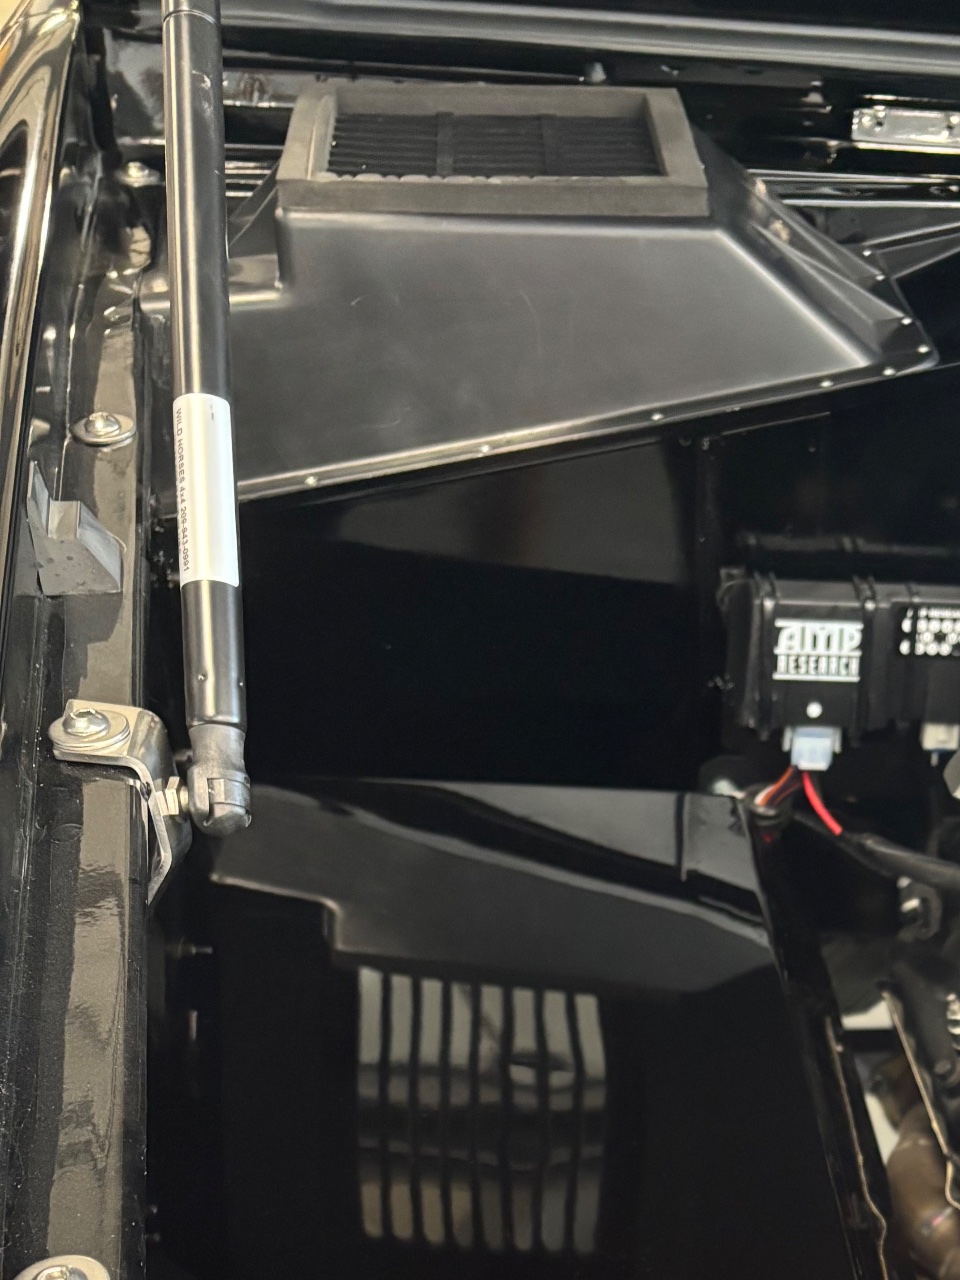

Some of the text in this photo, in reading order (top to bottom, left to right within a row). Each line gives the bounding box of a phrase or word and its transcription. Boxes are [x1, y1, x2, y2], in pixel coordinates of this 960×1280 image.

[175, 408, 183, 436] WILD
[177, 439, 185, 484] HORSES
[775, 622, 863, 650] AMP
